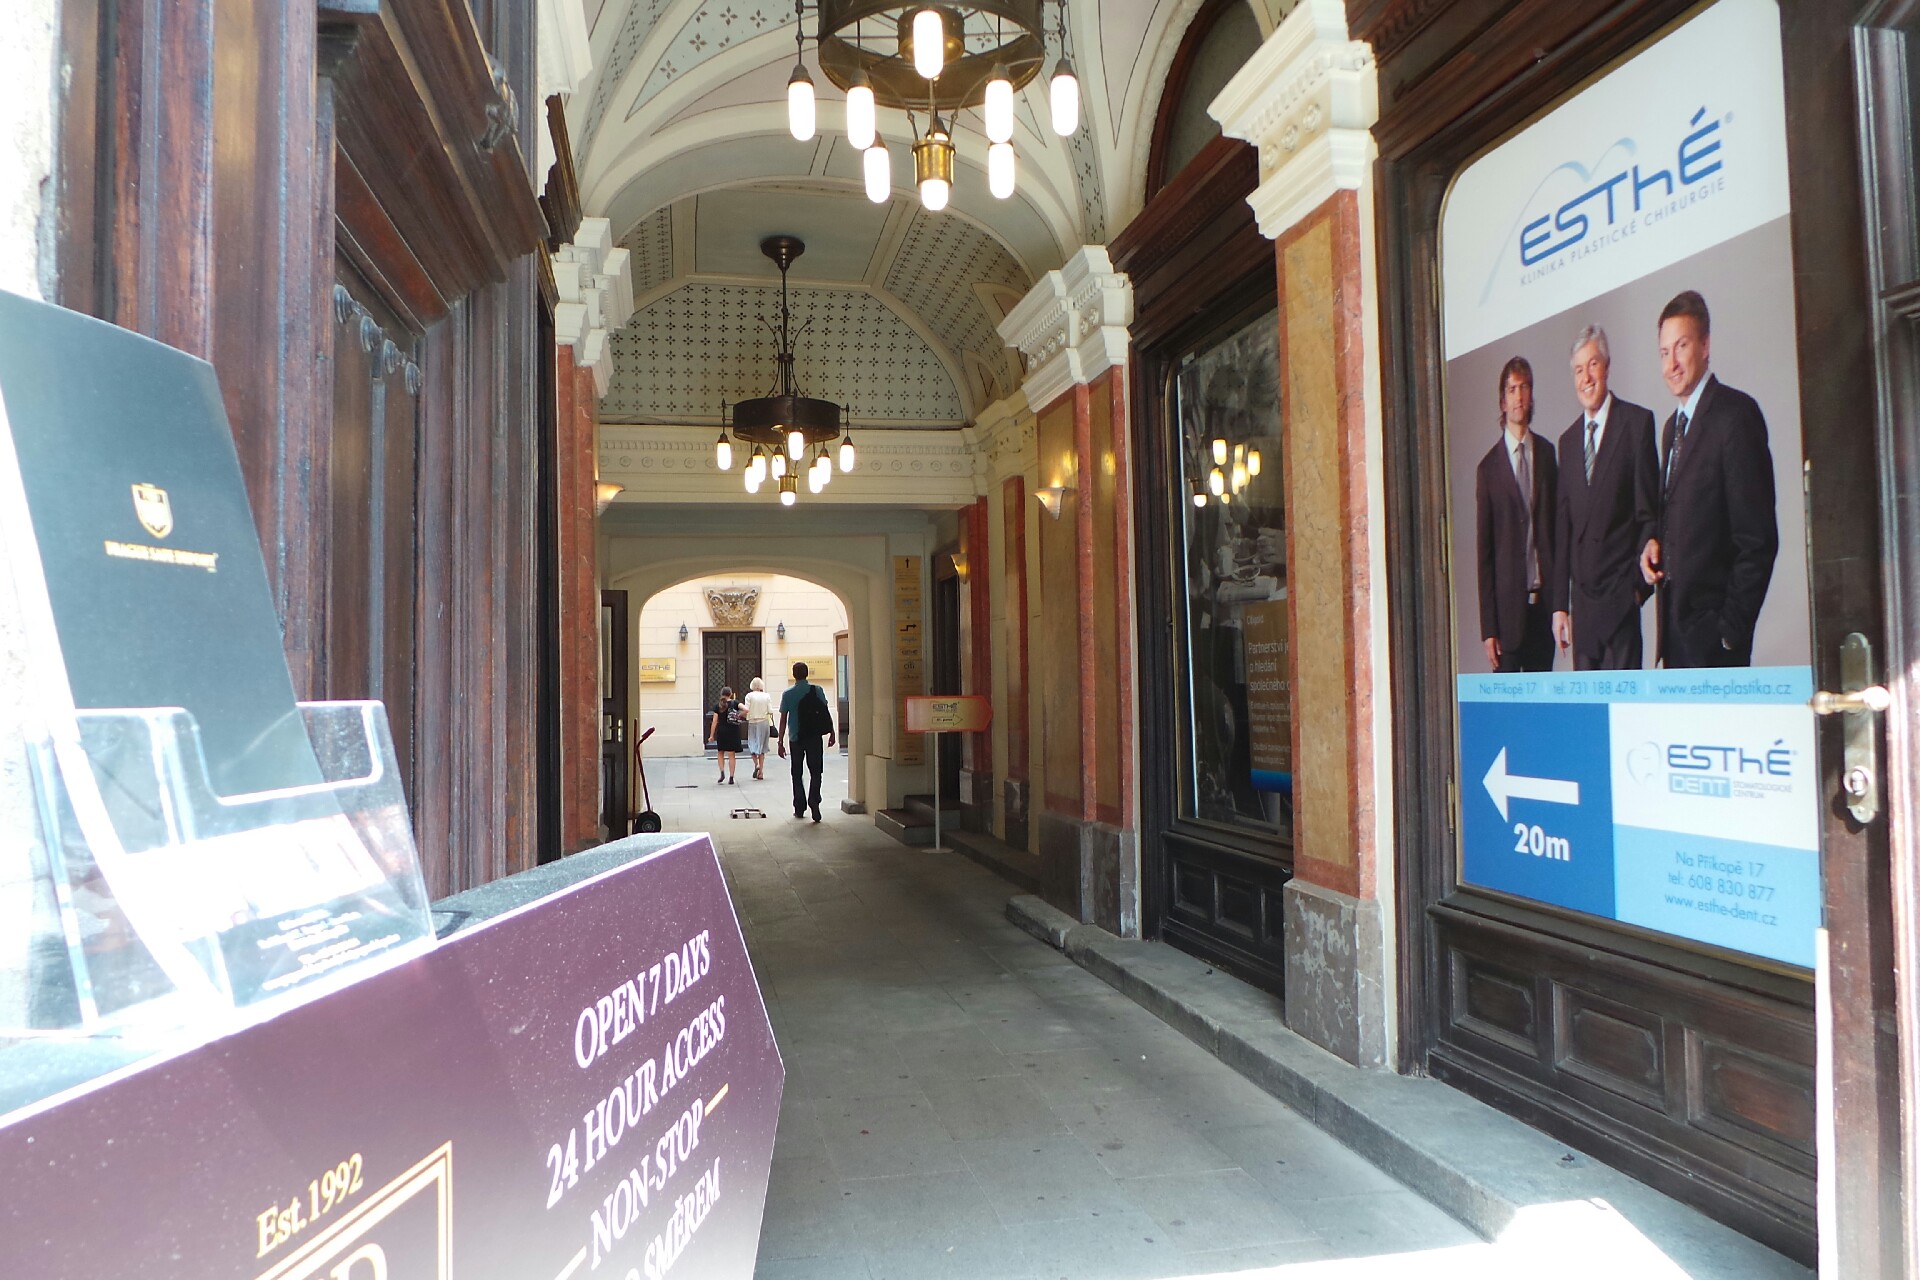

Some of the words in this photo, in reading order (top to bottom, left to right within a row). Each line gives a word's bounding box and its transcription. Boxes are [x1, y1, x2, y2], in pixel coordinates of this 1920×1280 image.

[1520, 257, 1565, 287] KLINIKA
[1570, 219, 1637, 263] PLASTICKÉ
[1644, 176, 1726, 227] CHIRURGIE
[1479, 682, 1492, 695] Na
[1526, 682, 1537, 695] 17
[1569, 681, 1588, 695] 731
[1592, 681, 1612, 695] 188
[1614, 681, 1637, 695] 478
[1657, 679, 1793, 699] www.esthe-plastika.cz
[1513, 822, 1570, 861] 20m
[1675, 851, 1694, 867] Na
[1748, 861, 1765, 877] 17
[1663, 893, 1778, 926] www.esthe-dent.cz
[1688, 874, 1713, 892] 608
[1717, 878, 1744, 897] 830
[1748, 884, 1776, 902] 877
[574, 970, 646, 1069] OPEN
[649, 962, 662, 1016] 7
[663, 929, 710, 1005] DAYS
[546, 1127, 579, 1210] 24
[583, 1057, 660, 1173] HOUR
[660, 994, 726, 1098] ACCESS
[590, 1096, 704, 1272] NON-STOP
[644, 1156, 721, 1280] SMĚREM
